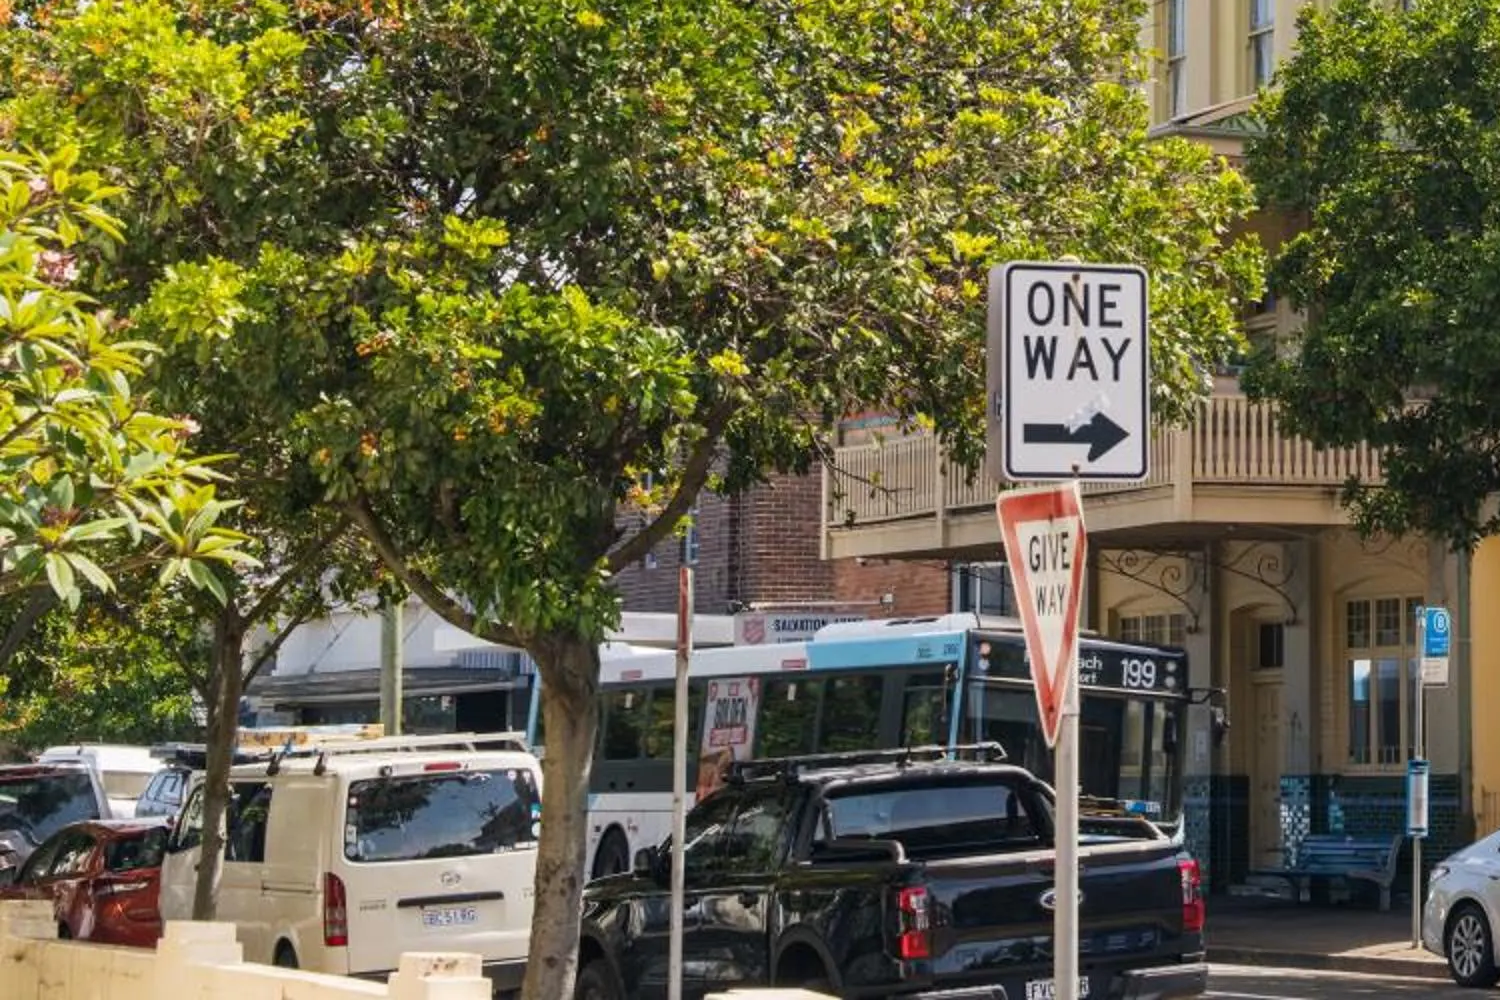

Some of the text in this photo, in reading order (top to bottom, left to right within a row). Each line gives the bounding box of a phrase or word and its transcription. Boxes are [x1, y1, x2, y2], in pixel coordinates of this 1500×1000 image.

[1027, 281, 1122, 329] ONE
[1024, 335, 1131, 382] WAY
[1029, 532, 1070, 573] GIVE
[1036, 584, 1066, 616] WAY
[1120, 658, 1156, 688] 199
